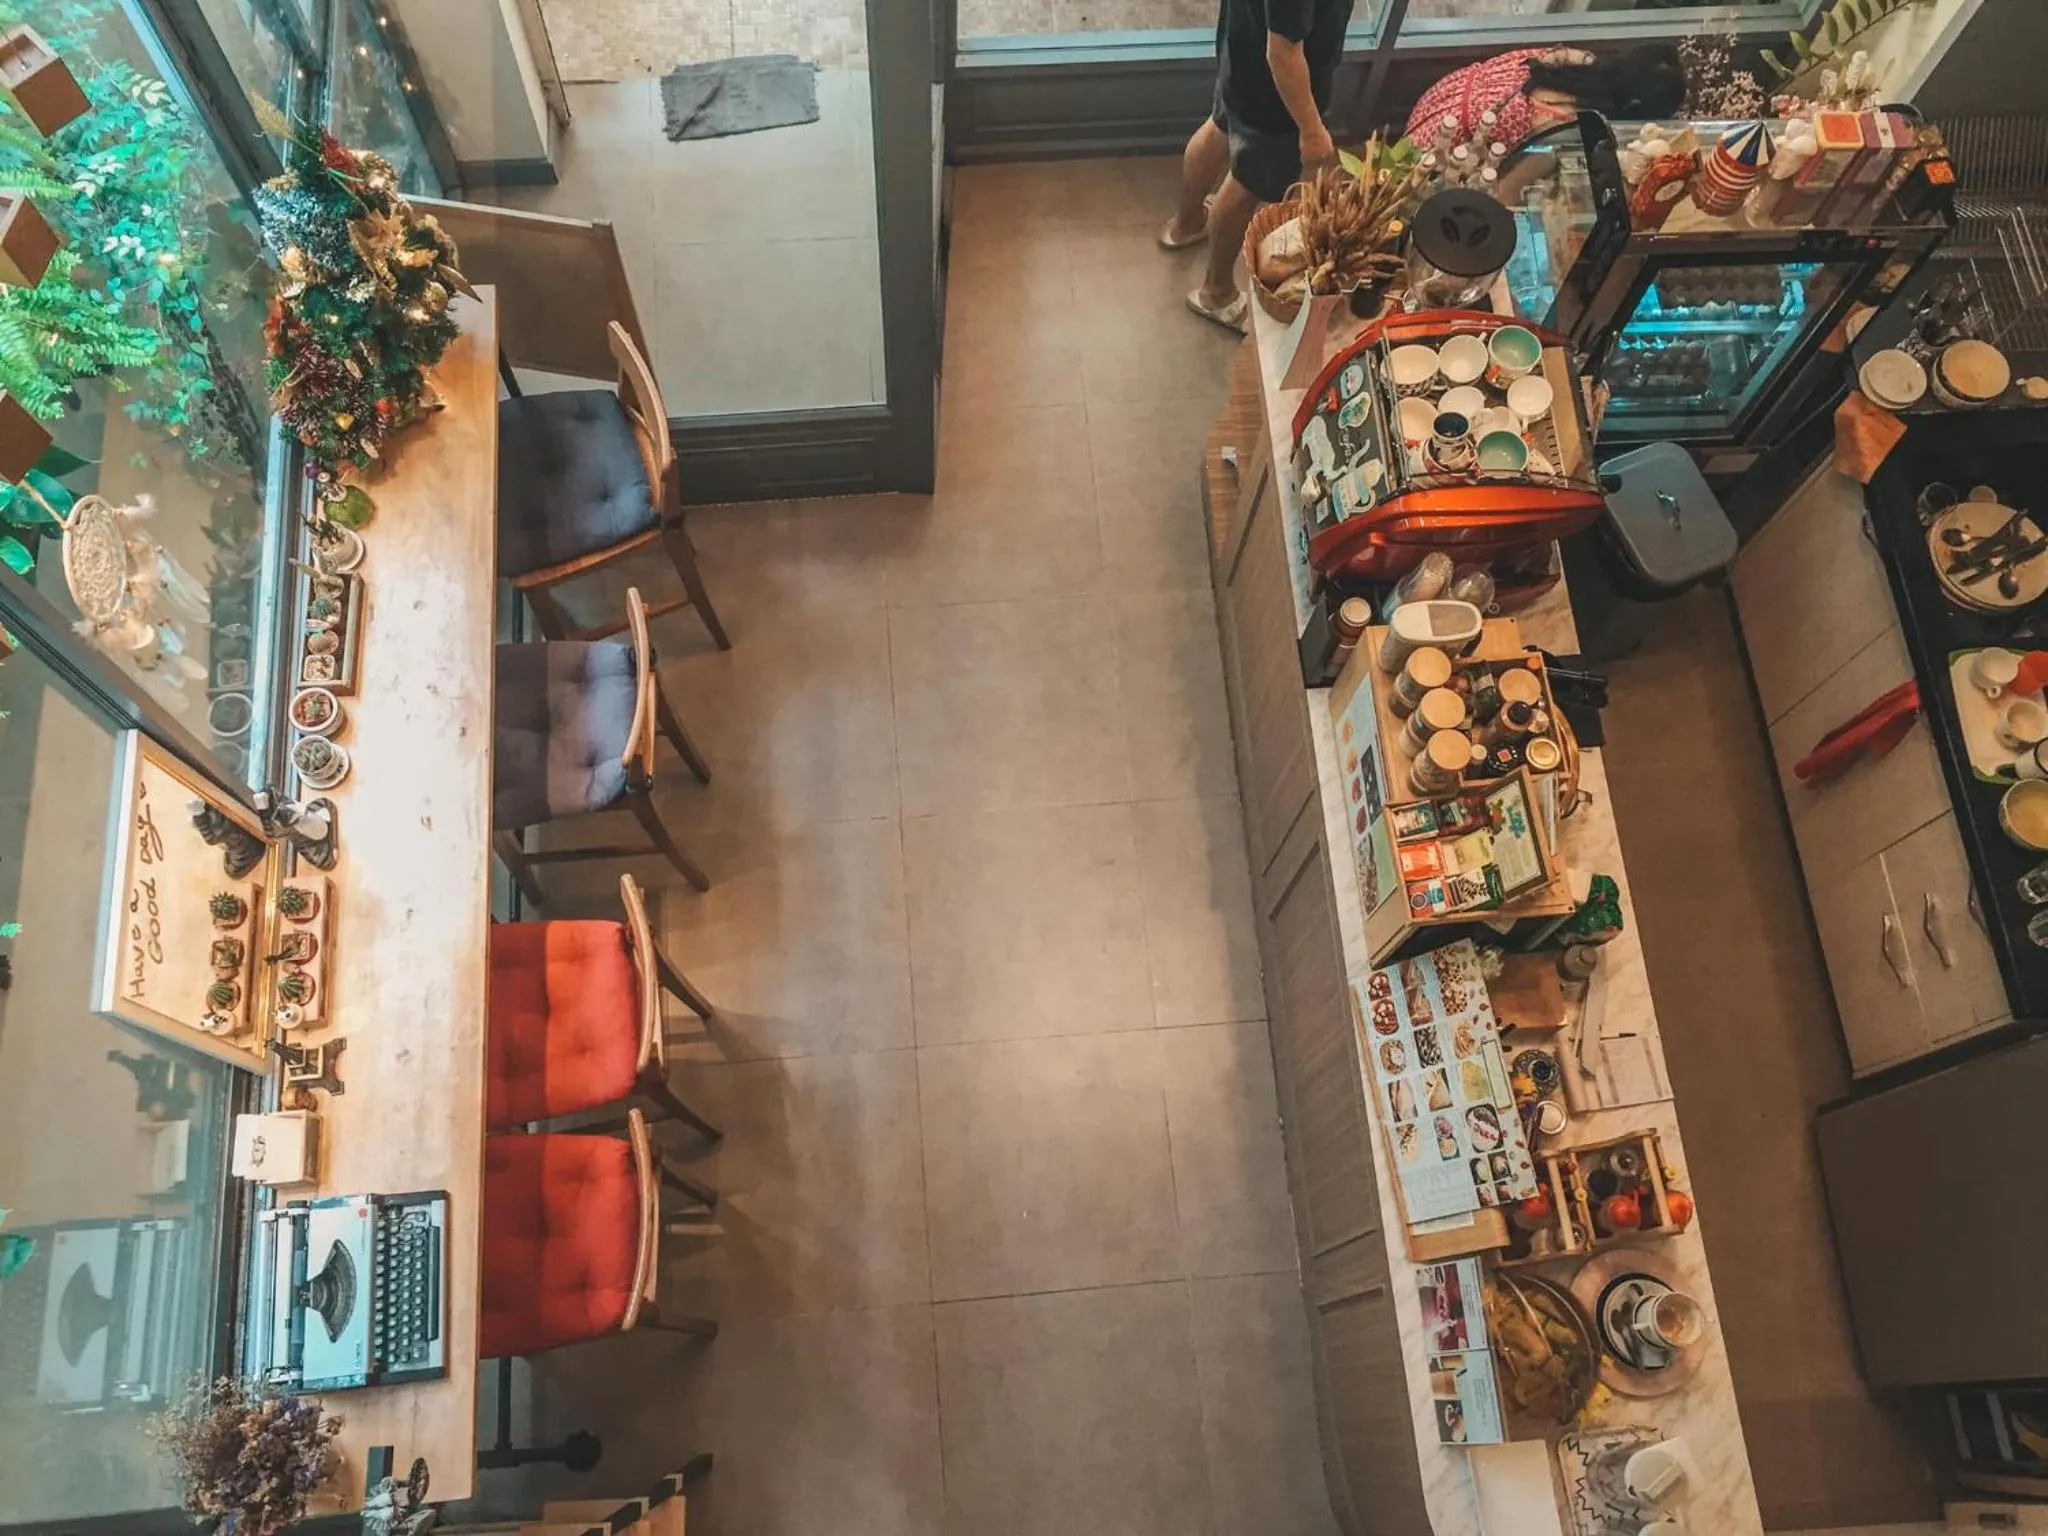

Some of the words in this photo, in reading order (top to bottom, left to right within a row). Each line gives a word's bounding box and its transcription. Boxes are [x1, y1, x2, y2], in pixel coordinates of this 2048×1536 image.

[129, 889, 140, 913] a
[140, 877, 163, 964] Good
[129, 926, 145, 998] Have
